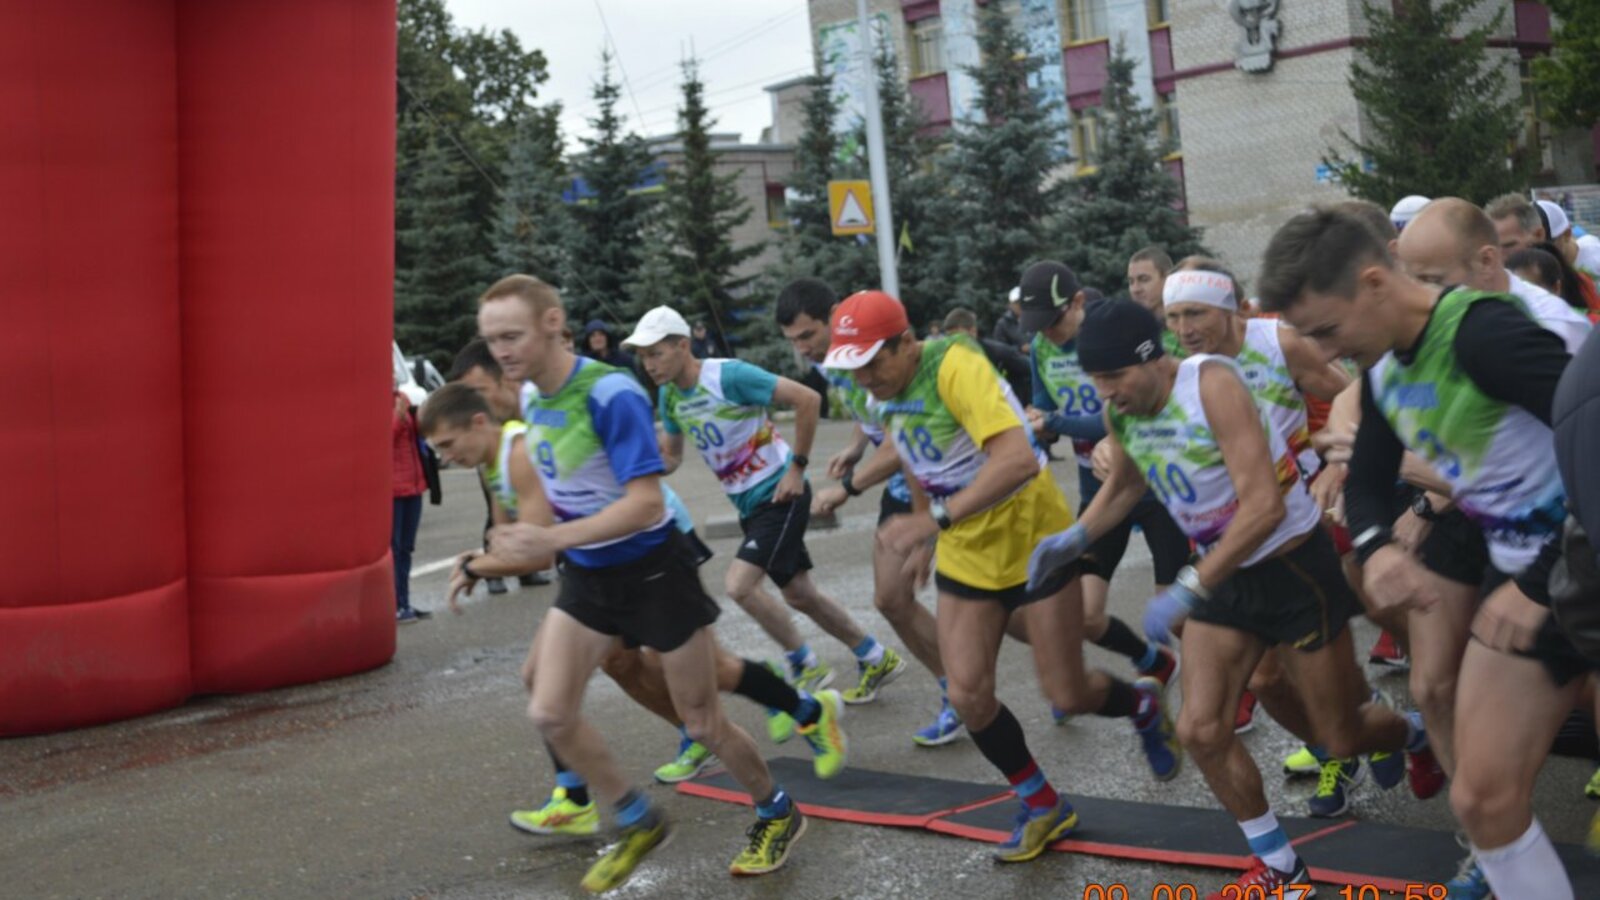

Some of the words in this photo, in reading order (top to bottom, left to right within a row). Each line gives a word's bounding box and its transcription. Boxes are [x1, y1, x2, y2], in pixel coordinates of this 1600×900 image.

[1057, 384, 1103, 416] 28
[689, 422, 724, 450] 30
[898, 427, 943, 463] 18
[537, 440, 556, 479] 9
[1147, 463, 1197, 505] 10
